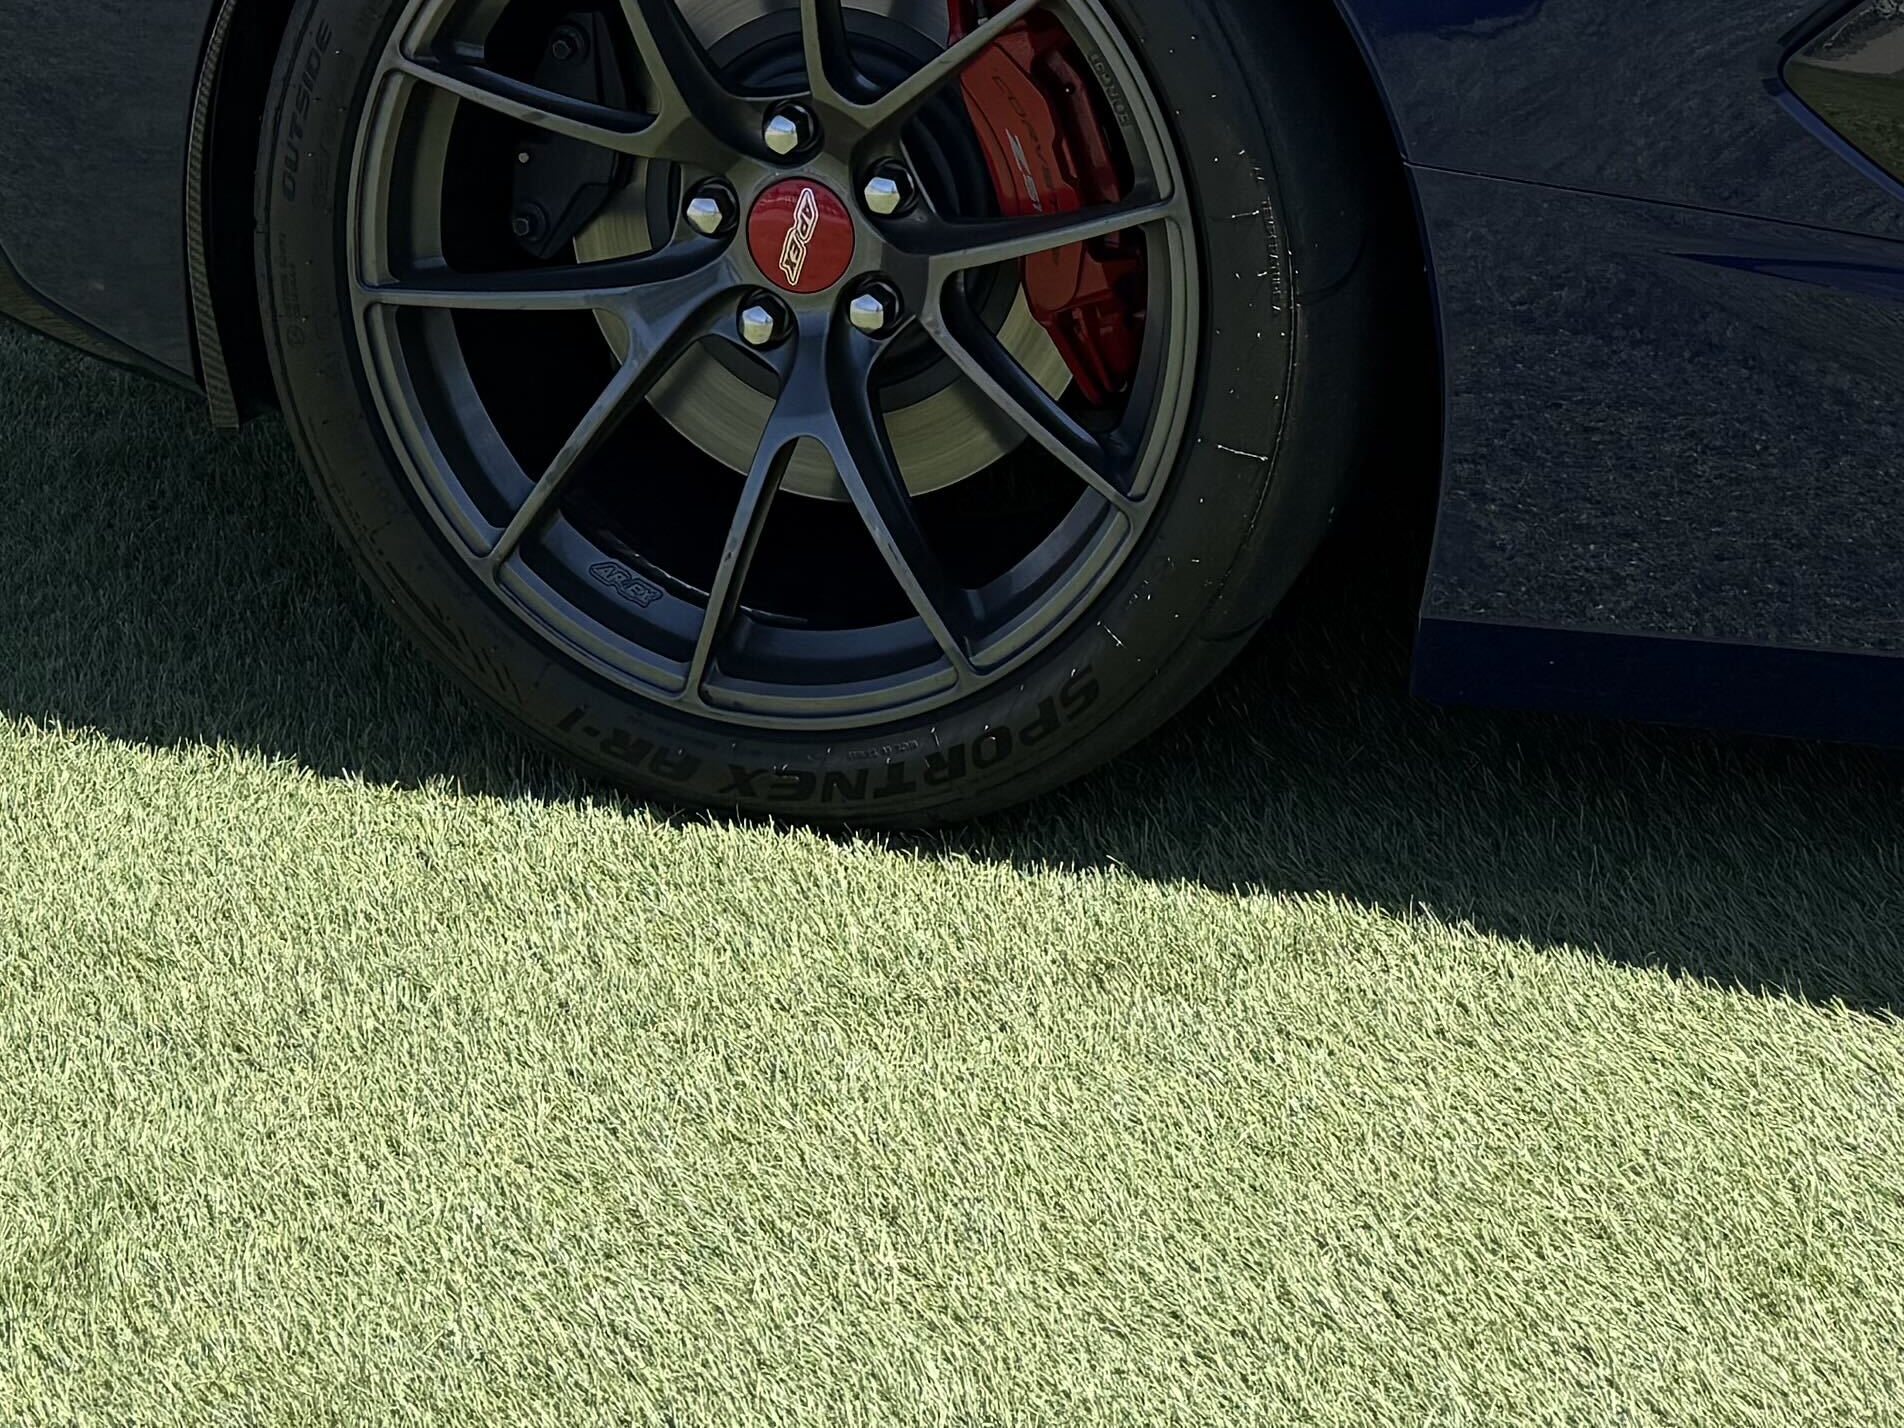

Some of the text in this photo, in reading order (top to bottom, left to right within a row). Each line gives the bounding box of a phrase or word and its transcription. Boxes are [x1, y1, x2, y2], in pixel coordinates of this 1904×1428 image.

[281, 17, 334, 203] OUTSIDE
[559, 664, 1102, 805] SPORTNEX AR-1
